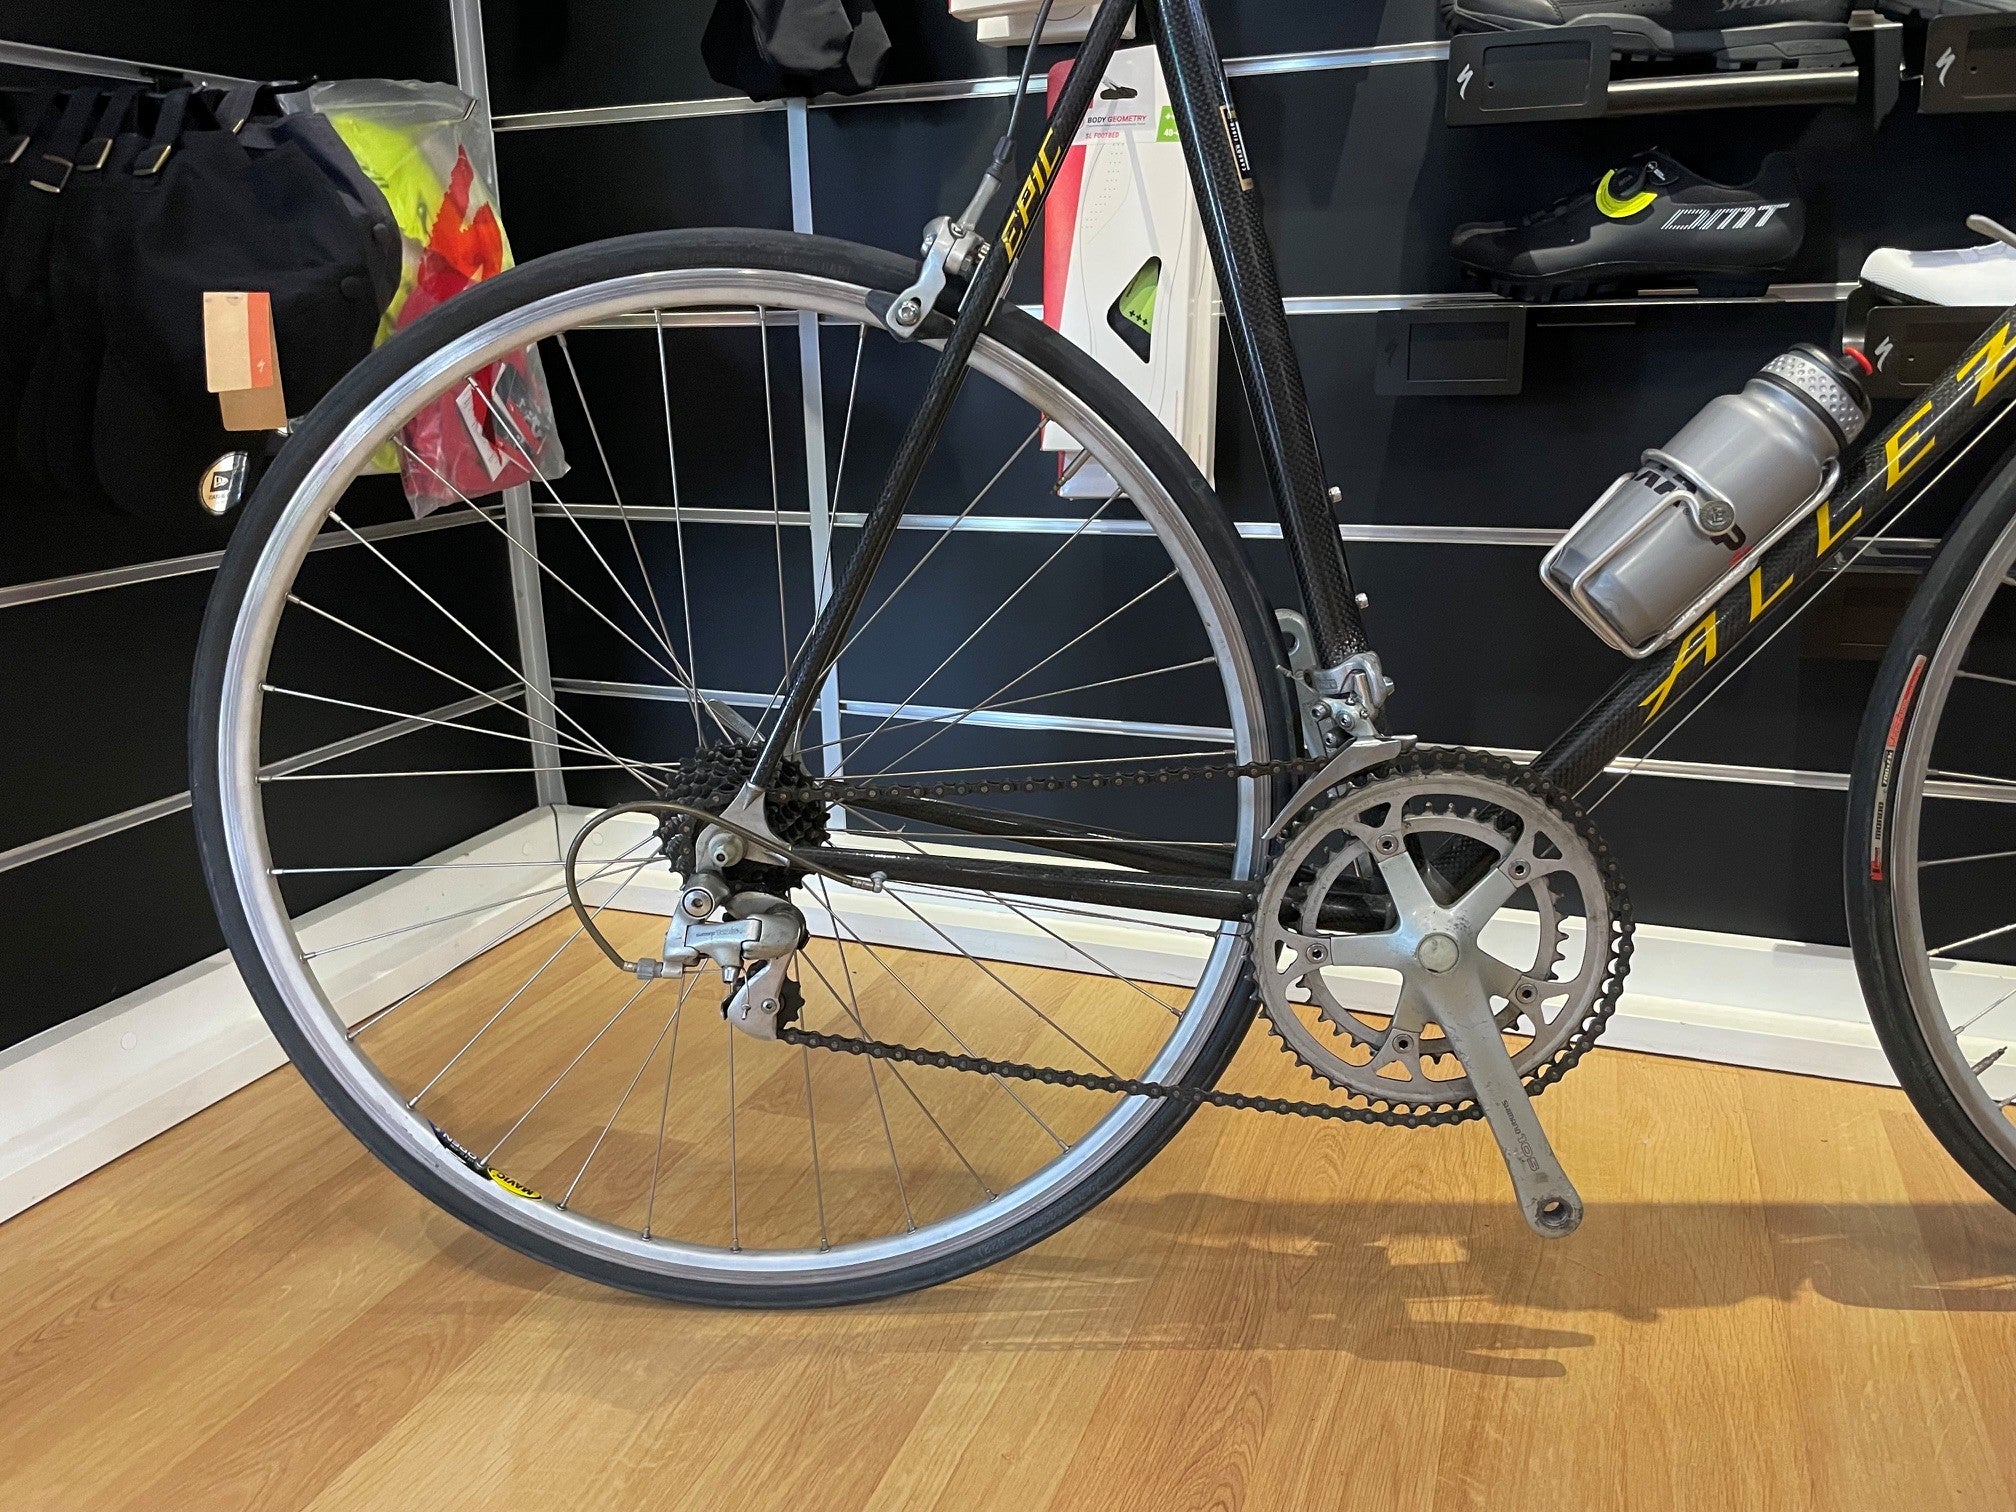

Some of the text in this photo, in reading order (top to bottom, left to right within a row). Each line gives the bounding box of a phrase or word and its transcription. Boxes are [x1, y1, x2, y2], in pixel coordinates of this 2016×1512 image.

[1087, 114, 1147, 124] BODY GEOMETRY
[1093, 131, 1120, 139] FOOTBED
[1235, 144, 1247, 171] CARBON
[1002, 126, 1062, 264] EPIC
[1660, 202, 1790, 231] DMT
[1517, 1133, 1540, 1172] 105
[496, 1172, 534, 1196] MAVIC
